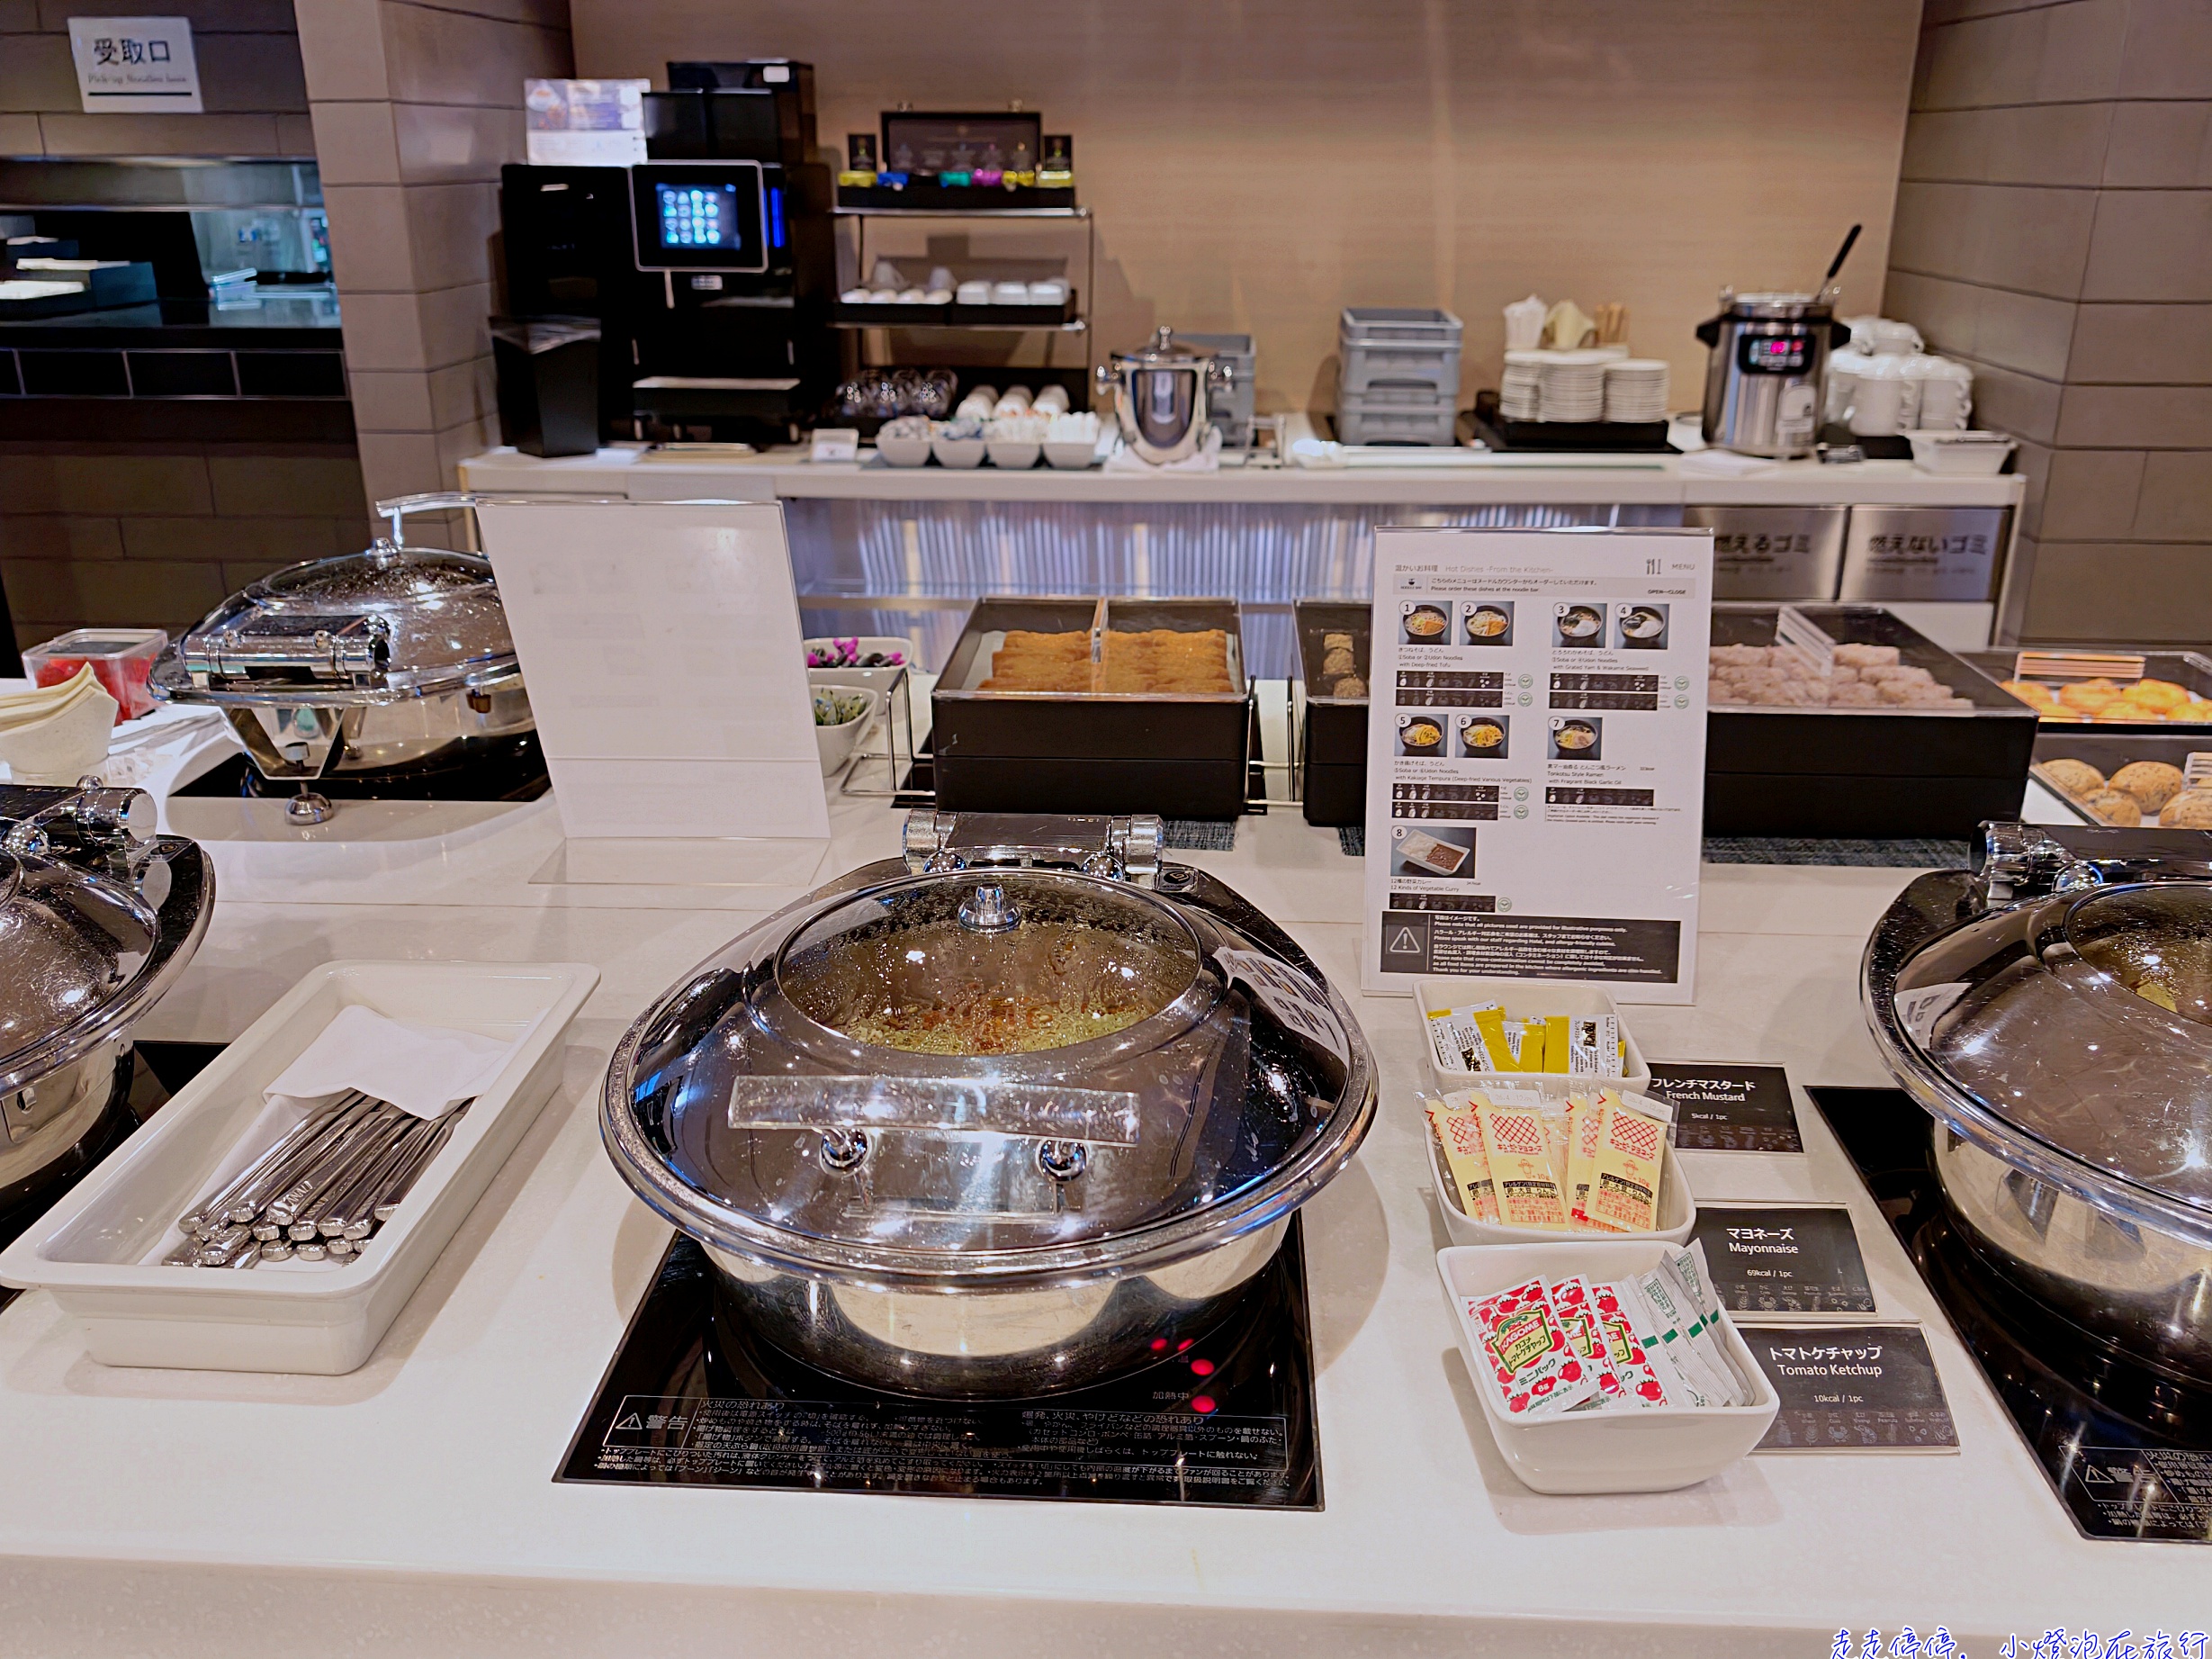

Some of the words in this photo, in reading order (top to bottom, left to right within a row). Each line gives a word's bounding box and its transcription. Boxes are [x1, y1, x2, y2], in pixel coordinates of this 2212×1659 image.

[94, 38, 171, 65] 受取口
[1405, 604, 1409, 612] 1
[1465, 605, 1471, 613] 2
[1559, 605, 1564, 614] 3
[1620, 607, 1626, 615] 4
[1399, 717, 1406, 725] 5
[1461, 717, 1466, 726] 6
[1553, 719, 1560, 727] 7
[1397, 828, 1403, 837] 8
[1651, 1078, 1757, 1092] フレンチマスタード
[1666, 1090, 1700, 1100] French
[1702, 1091, 1747, 1102] Mustard
[1726, 1228, 1794, 1240] マヨネーズ
[1728, 1242, 1799, 1256] Mayonnaise
[1747, 1269, 1771, 1277] 69kcal
[1779, 1270, 1793, 1278] 1pc
[1499, 1320, 1541, 1352] KAGOME
[1515, 1336, 1532, 1351] カゴメ
[1507, 1335, 1546, 1366] トマトケチャップ
[1769, 1346, 1883, 1361] トマトケチャップ
[1518, 1357, 1556, 1385] ミニパック
[1776, 1364, 1828, 1375] Tomato
[1830, 1364, 1883, 1378] Ketchup
[1537, 1381, 1550, 1393] 8g
[1153, 1391, 1189, 1401] 加熱中
[1813, 1394, 1839, 1403] 10kcal
[1848, 1395, 1864, 1404] 1pc
[701, 1400, 785, 1411] 火災の恐れあり
[646, 1414, 688, 1430] 警告
[1022, 1411, 1204, 1425] 爆発、火災、やけどなどの恐れあり
